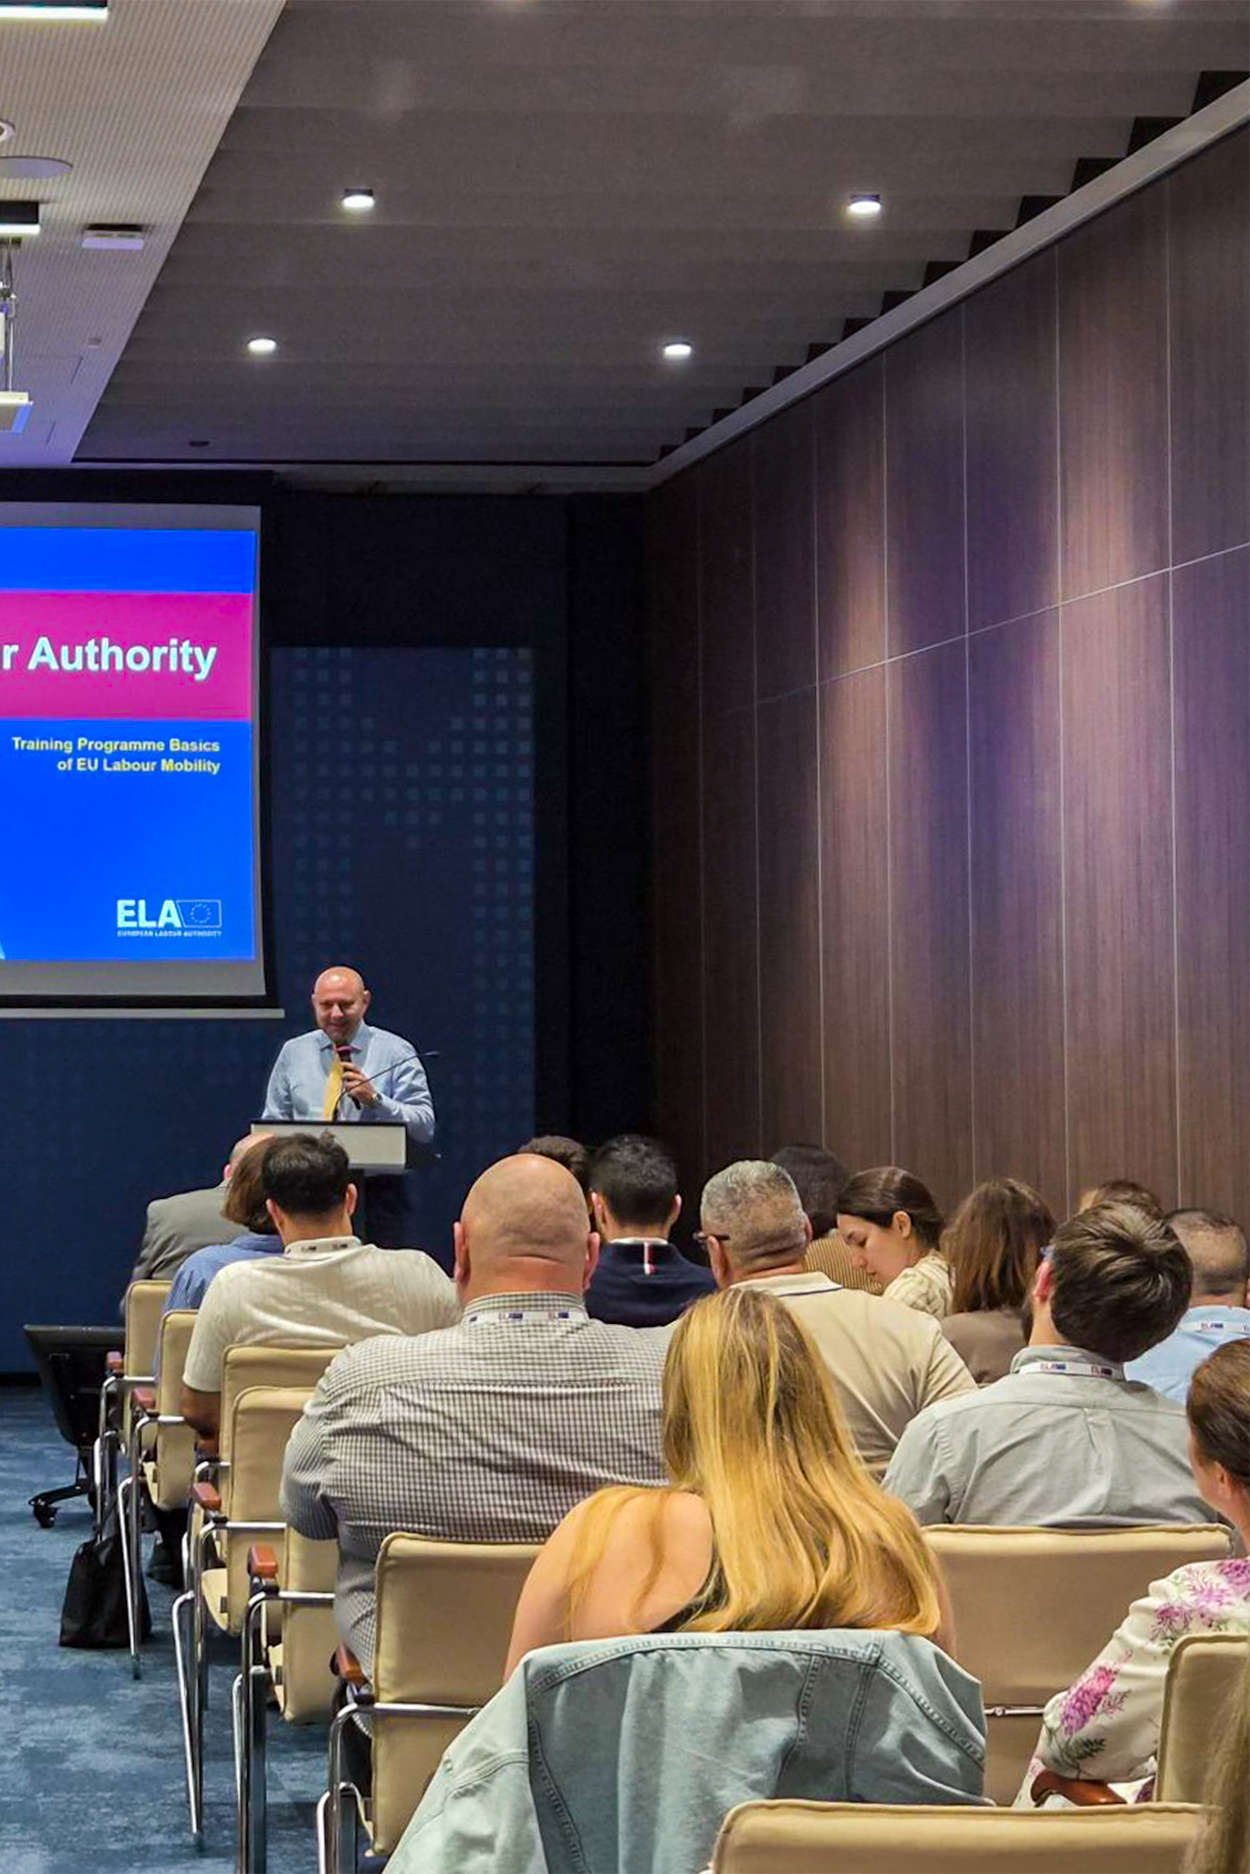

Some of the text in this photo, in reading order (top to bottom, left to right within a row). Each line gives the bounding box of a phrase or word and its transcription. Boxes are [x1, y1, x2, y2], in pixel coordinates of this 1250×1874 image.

[27, 636, 217, 681] Authority
[11, 737, 220, 754] Training Programme Basics
[57, 758, 221, 775] of EU Labour Mobility
[117, 899, 182, 928] ELA
